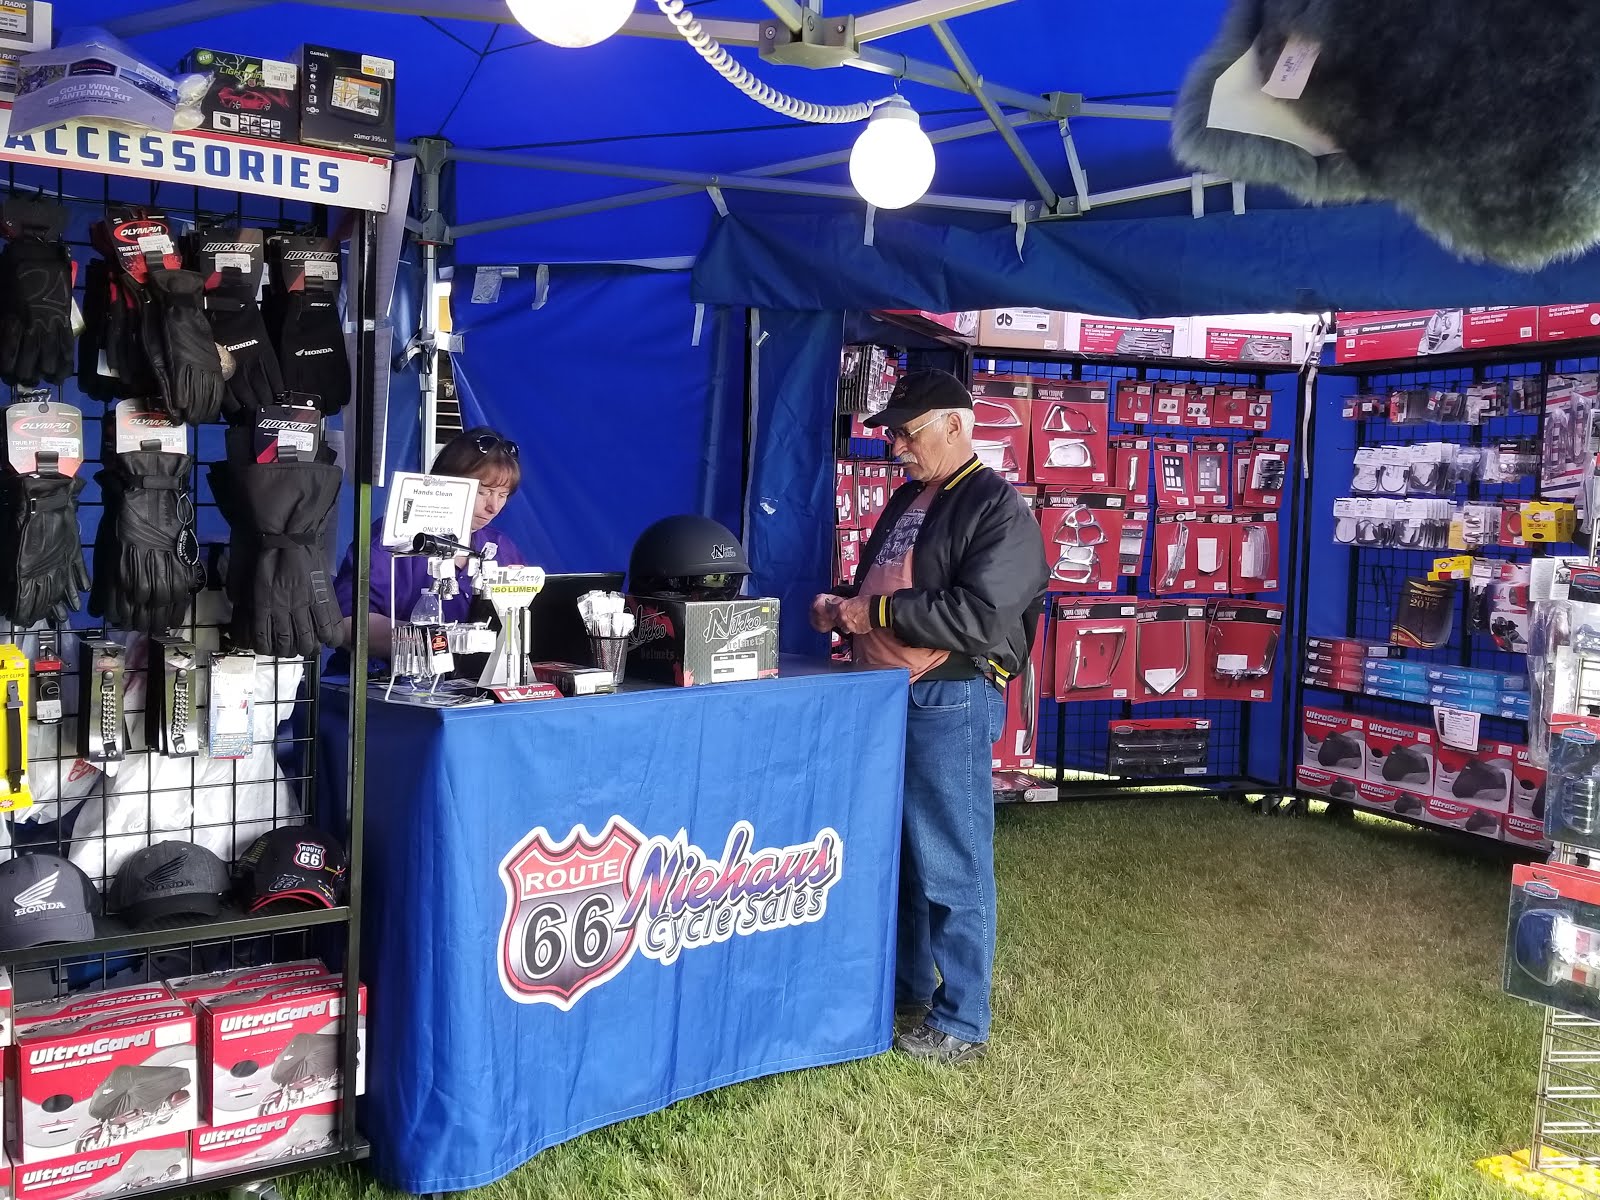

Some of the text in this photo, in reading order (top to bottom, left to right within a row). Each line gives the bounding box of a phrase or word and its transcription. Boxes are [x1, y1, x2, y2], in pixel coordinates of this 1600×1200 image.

[4, 0, 27, 9] RADIO
[198, 53, 212, 61] NEW!
[309, 50, 329, 58] GARMIN
[60, 83, 121, 95] GOLD WING
[48, 96, 60, 105] CB
[61, 90, 112, 101] ANTENNA
[114, 92, 133, 102] KIT
[120, 225, 162, 236] OLYMPIA
[202, 242, 261, 253] ROCKET
[283, 250, 339, 261] ROCKET
[227, 339, 259, 352] HONDA
[304, 347, 334, 356] HONDA
[19, 422, 72, 430] OLYMPIA
[128, 418, 173, 427] OLYMPI
[257, 418, 318, 432] ROCKET
[413, 488, 433, 496] Hands
[510, 570, 541, 584] Larry
[703, 604, 761, 643] Nikko
[525, 688, 556, 698] Larry
[1306, 710, 1349, 725] UltraGard
[1368, 722, 1415, 738] UltraGard
[1429, 799, 1469, 813] UltraGard
[301, 845, 322, 855] ROUTE
[299, 852, 320, 866] 66
[524, 858, 620, 893] ROUTE
[613, 825, 839, 933] Niehaus
[14, 902, 66, 917] HONDA
[646, 886, 824, 958] Cycle Sales
[521, 894, 616, 980] 66
[220, 1000, 327, 1033] UltraGard
[29, 1030, 152, 1067] UltraGard
[198, 1117, 288, 1146] UltraGard
[22, 1153, 122, 1184] UltraGard
